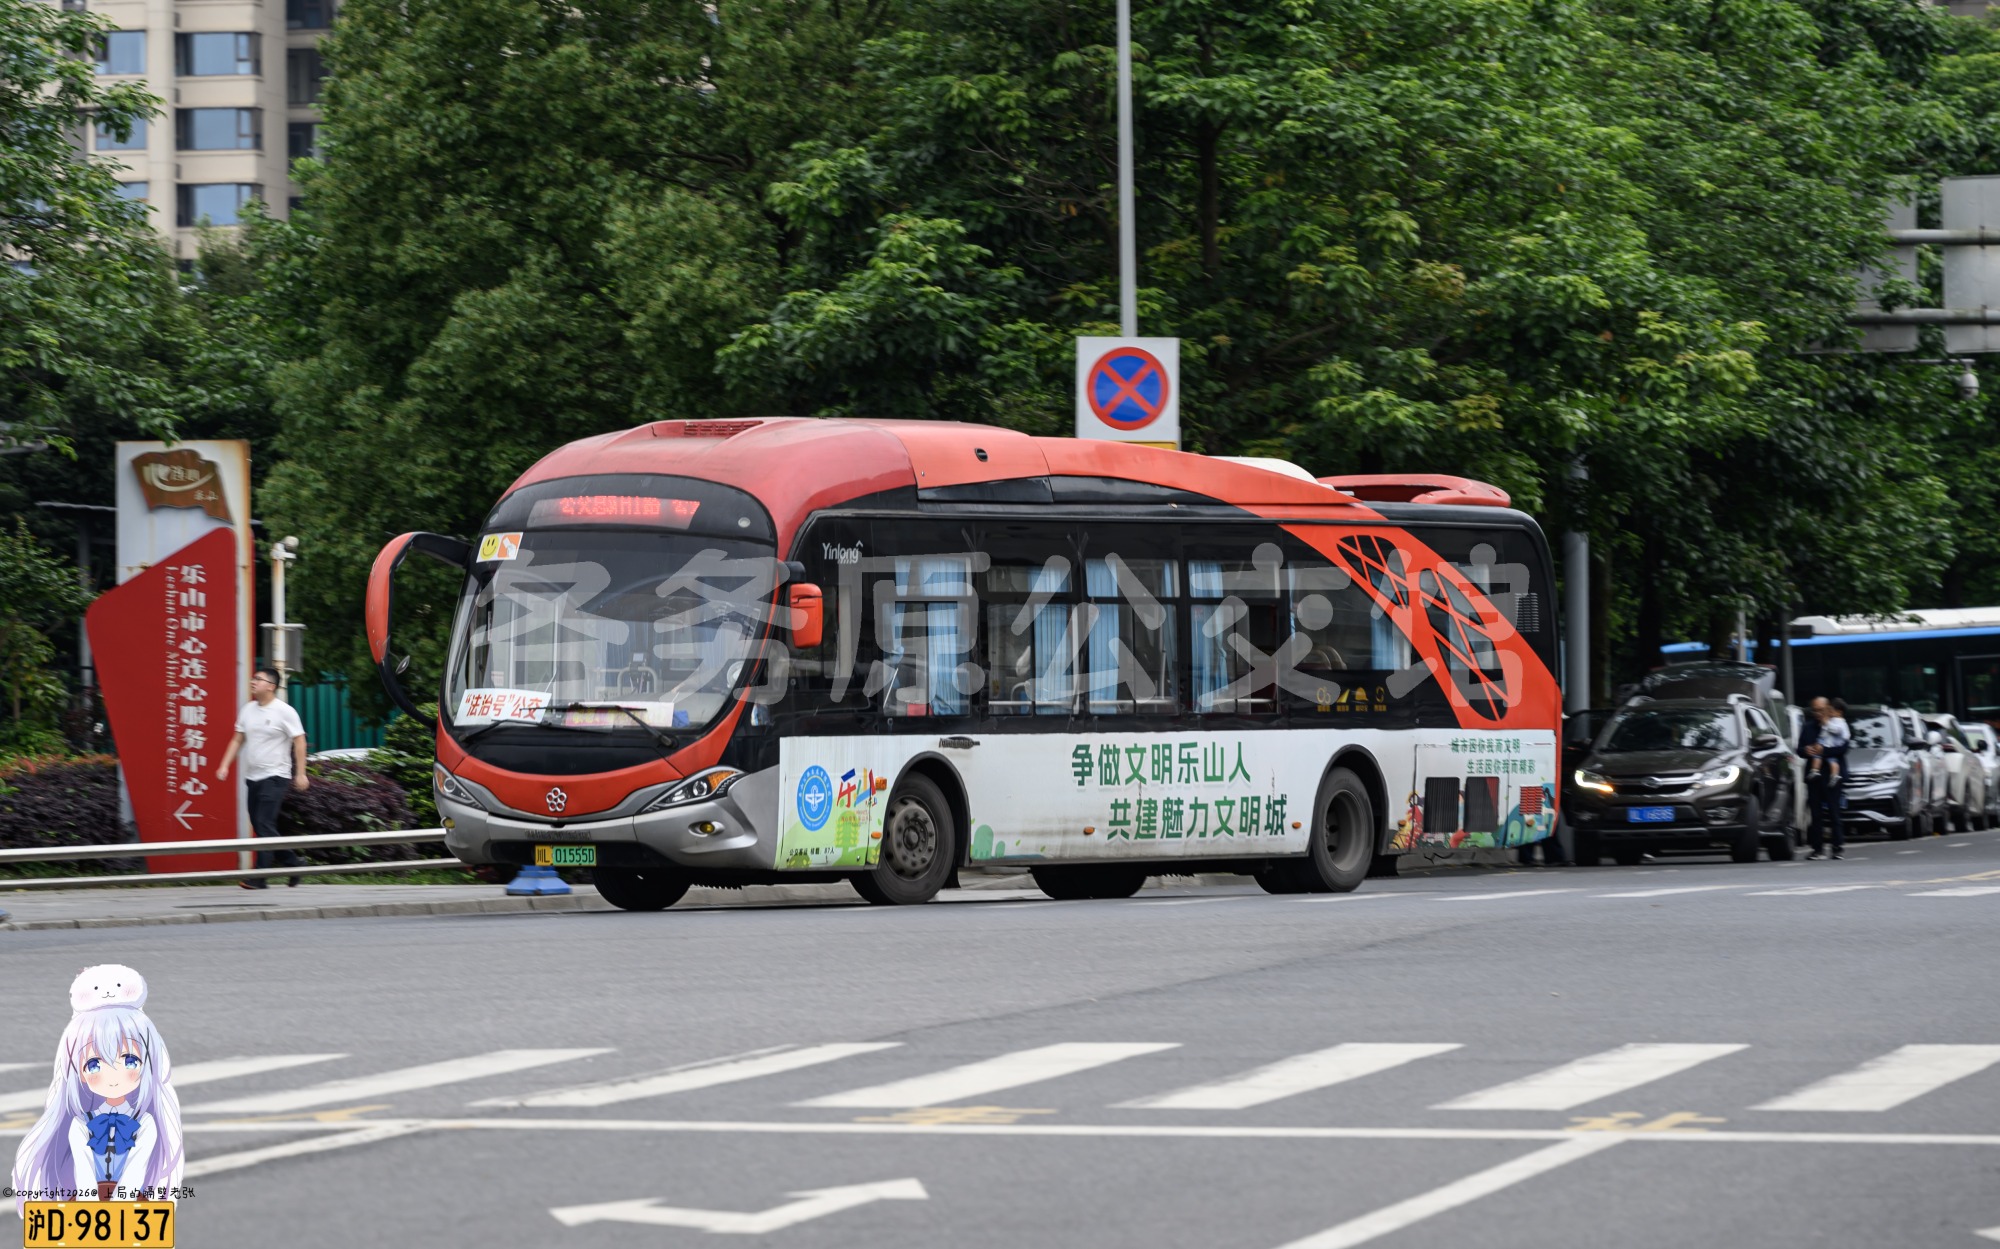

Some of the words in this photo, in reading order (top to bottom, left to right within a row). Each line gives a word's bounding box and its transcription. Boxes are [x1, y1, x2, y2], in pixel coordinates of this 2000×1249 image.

[822, 542, 859, 564] Yinlong
[165, 617, 180, 646] One
[165, 651, 180, 687] Mind
[179, 564, 208, 796] 乐山市心连心服务中心
[165, 692, 180, 743] Service
[165, 747, 180, 794] Center
[1072, 741, 1251, 787] 争做文明乐山人
[1107, 793, 1288, 841] 共建魅力文明城
